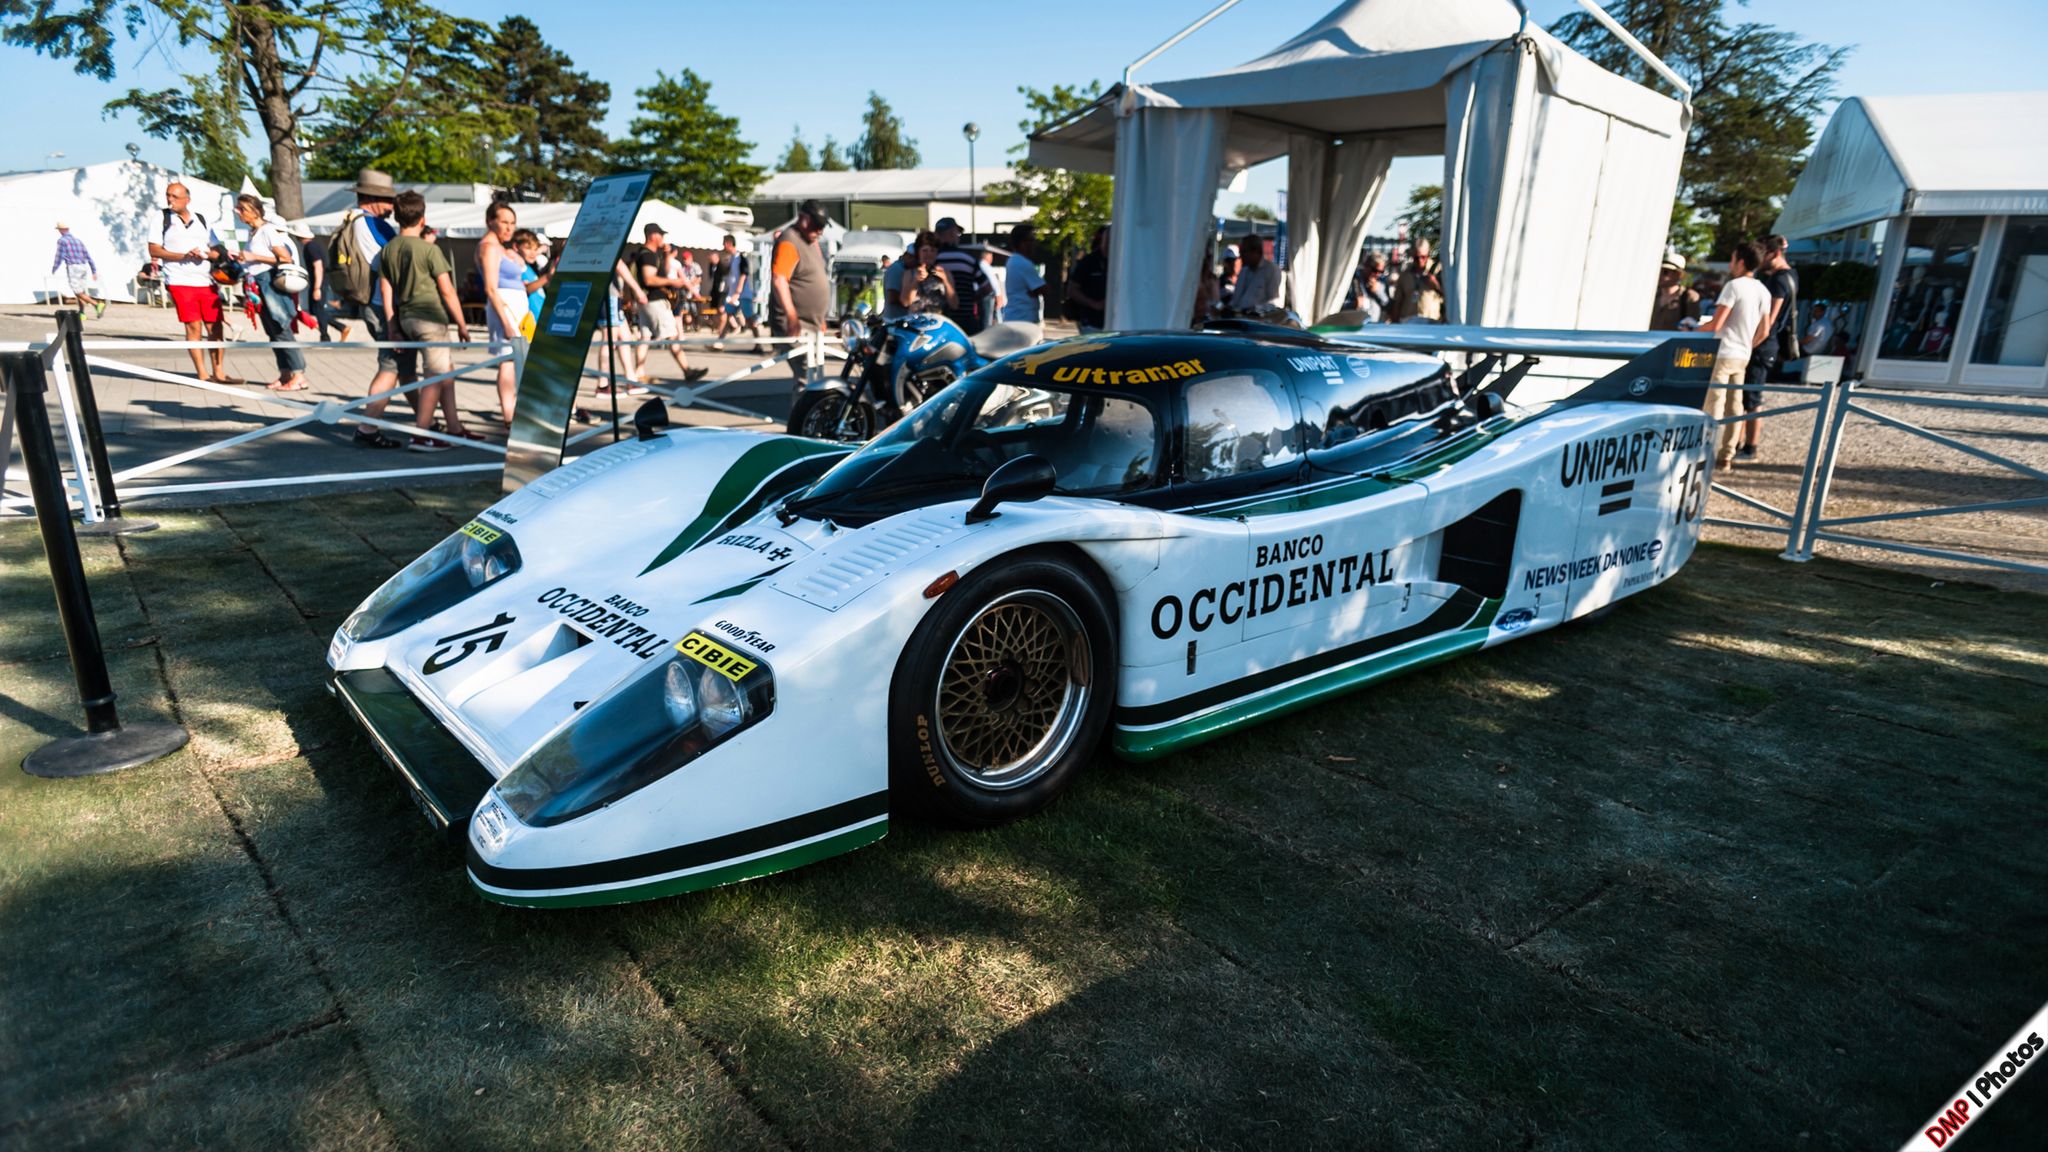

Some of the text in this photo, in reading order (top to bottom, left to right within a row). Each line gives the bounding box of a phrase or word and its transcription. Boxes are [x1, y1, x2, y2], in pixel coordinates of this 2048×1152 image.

[1052, 358, 1206, 385] Ultramar
[1287, 355, 1340, 372] UNIPART
[1661, 423, 1704, 453] RIZLA
[1560, 430, 1655, 488] UNIPART
[1674, 459, 1707, 526] 15
[464, 522, 498, 542] CIBIE
[716, 535, 775, 554] RIZLA
[1255, 534, 1324, 568] BANCO
[1524, 542, 1649, 591] NEWSWEEK DANONE
[604, 594, 650, 617] BANCO
[1150, 549, 1394, 640] OCCIDENTAL
[537, 587, 670, 660] OCCIDENTAL
[714, 619, 776, 653] GOODYEAR
[422, 611, 517, 676] 15
[682, 638, 750, 677] CIBIE
[916, 713, 946, 787] DUNLOP
